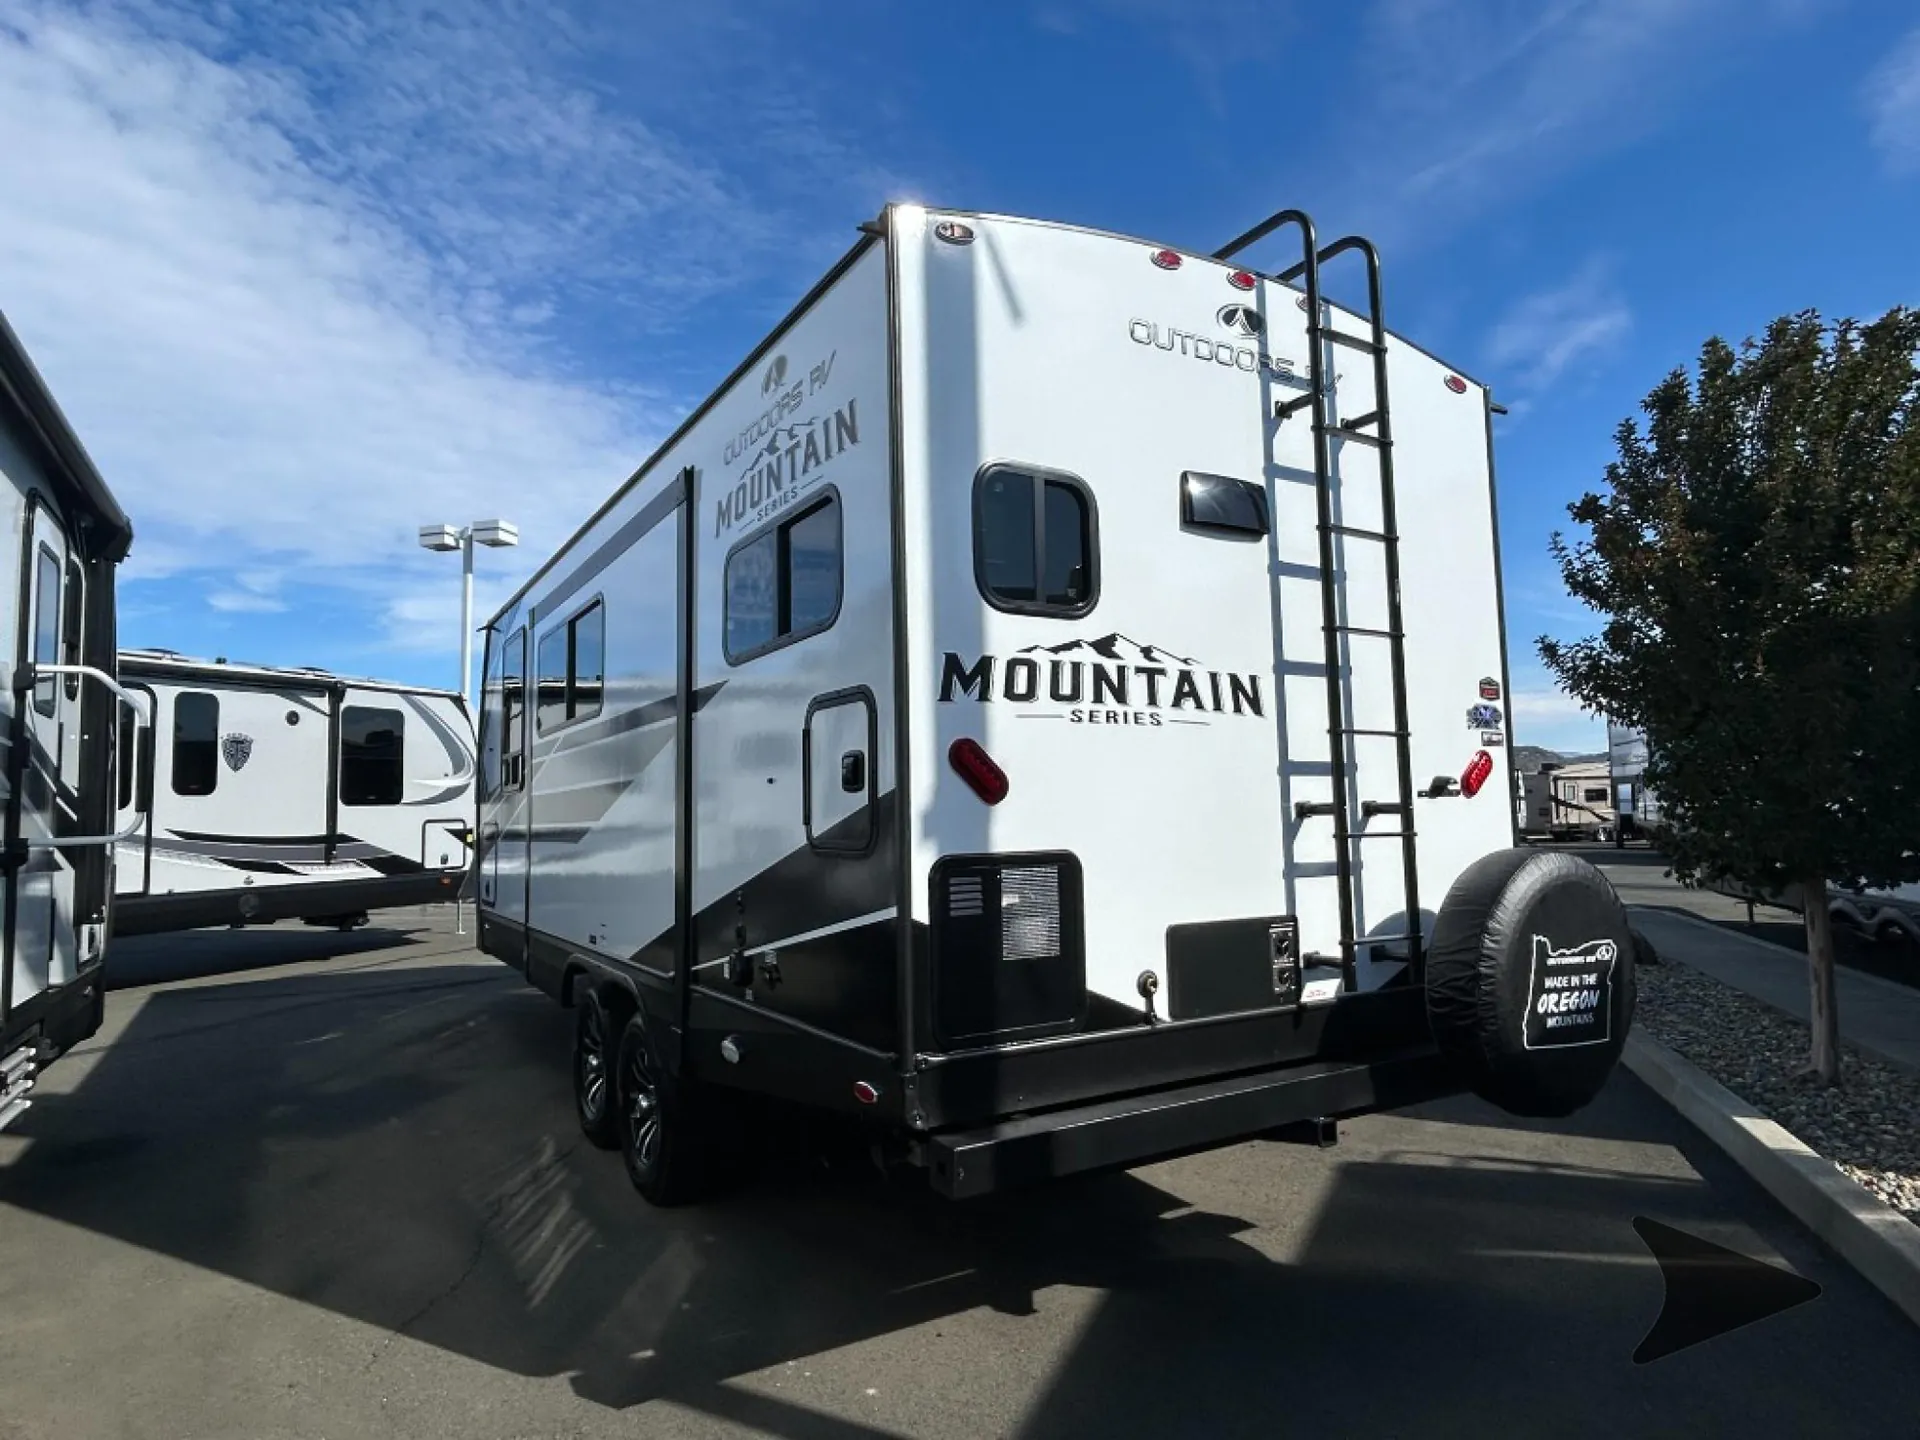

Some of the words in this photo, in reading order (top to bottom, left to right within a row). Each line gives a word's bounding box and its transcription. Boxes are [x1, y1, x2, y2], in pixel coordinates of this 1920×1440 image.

[1129, 317, 1295, 383] OUTDOORS
[723, 379, 804, 466] OUTDOORS
[809, 349, 837, 396] RV
[714, 397, 861, 540] MOUNTAIN
[756, 486, 799, 523] SERIES
[937, 651, 1266, 719] MOUNTAIN
[1069, 709, 1163, 727] SERIES
[1544, 976, 1569, 988] MADE
[1571, 975, 1580, 987] IN
[1582, 973, 1598, 986] THE
[1537, 989, 1600, 1014] OREGON
[1546, 1012, 1595, 1029] MOUNTAINS
